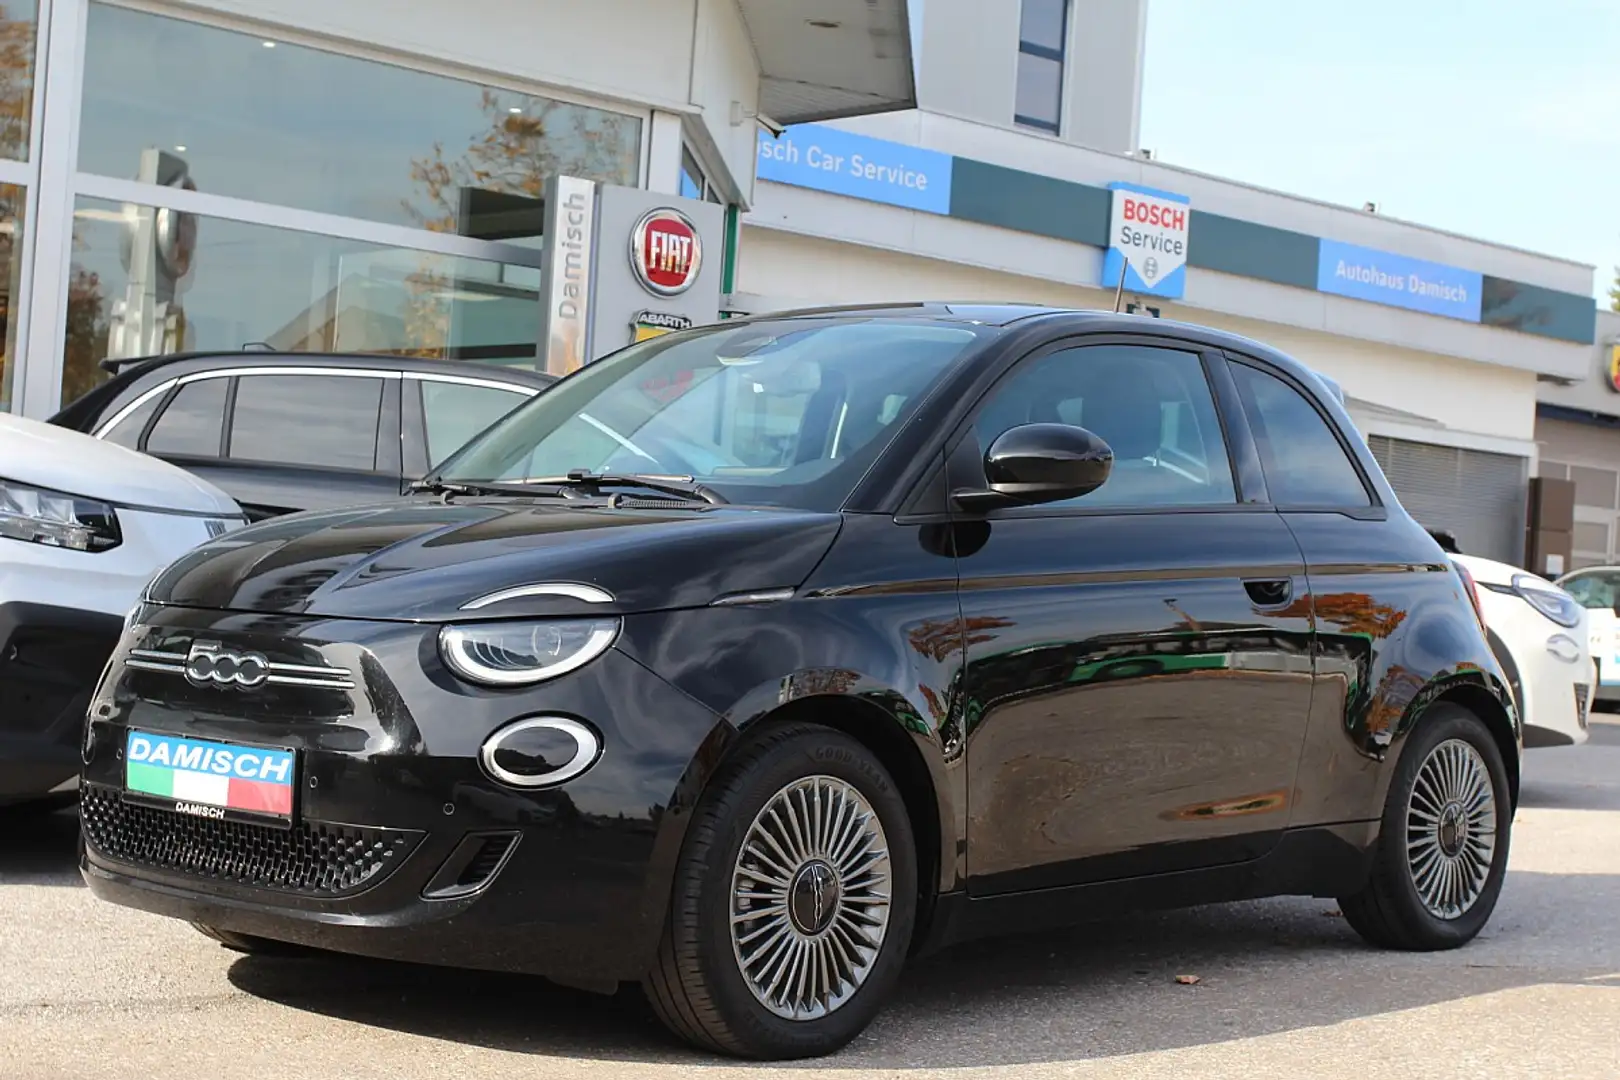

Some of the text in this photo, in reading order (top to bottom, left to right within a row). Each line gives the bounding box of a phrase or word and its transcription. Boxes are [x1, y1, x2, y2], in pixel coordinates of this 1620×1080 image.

[806, 145, 845, 173] Car
[851, 154, 928, 191] Service
[1123, 198, 1184, 231] BOSCH
[558, 192, 585, 320] Damisch
[650, 230, 692, 274] FIAT
[1120, 225, 1183, 255] Service
[1335, 259, 1468, 303] Autohaus Damisch
[640, 313, 691, 329] ABARTH
[127, 737, 292, 781] DAMISCH
[175, 802, 225, 819] DAMISCH
